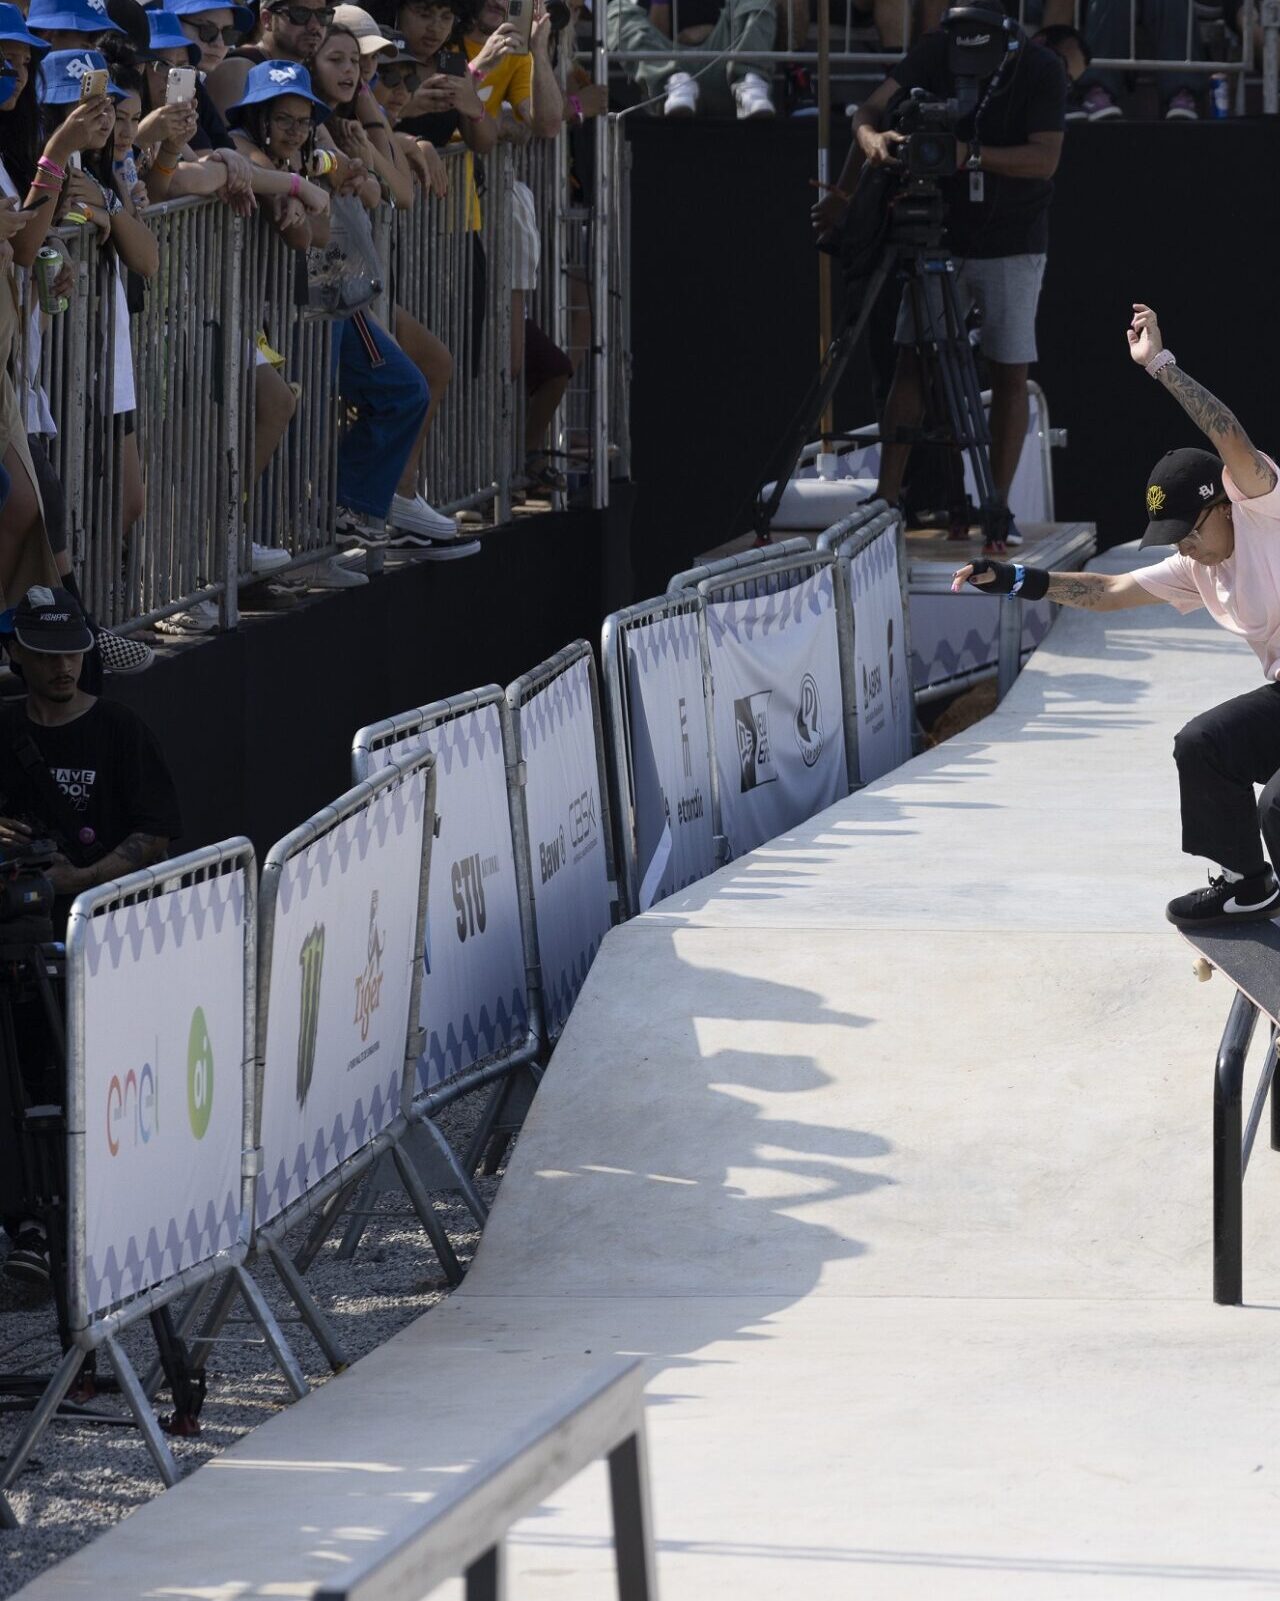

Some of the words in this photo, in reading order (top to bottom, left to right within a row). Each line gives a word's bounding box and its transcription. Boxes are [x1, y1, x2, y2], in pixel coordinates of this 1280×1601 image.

[451, 853, 486, 943] STU
[539, 841, 560, 885] Baw
[353, 970, 384, 1042] Tiger
[107, 1035, 159, 1157] enel
